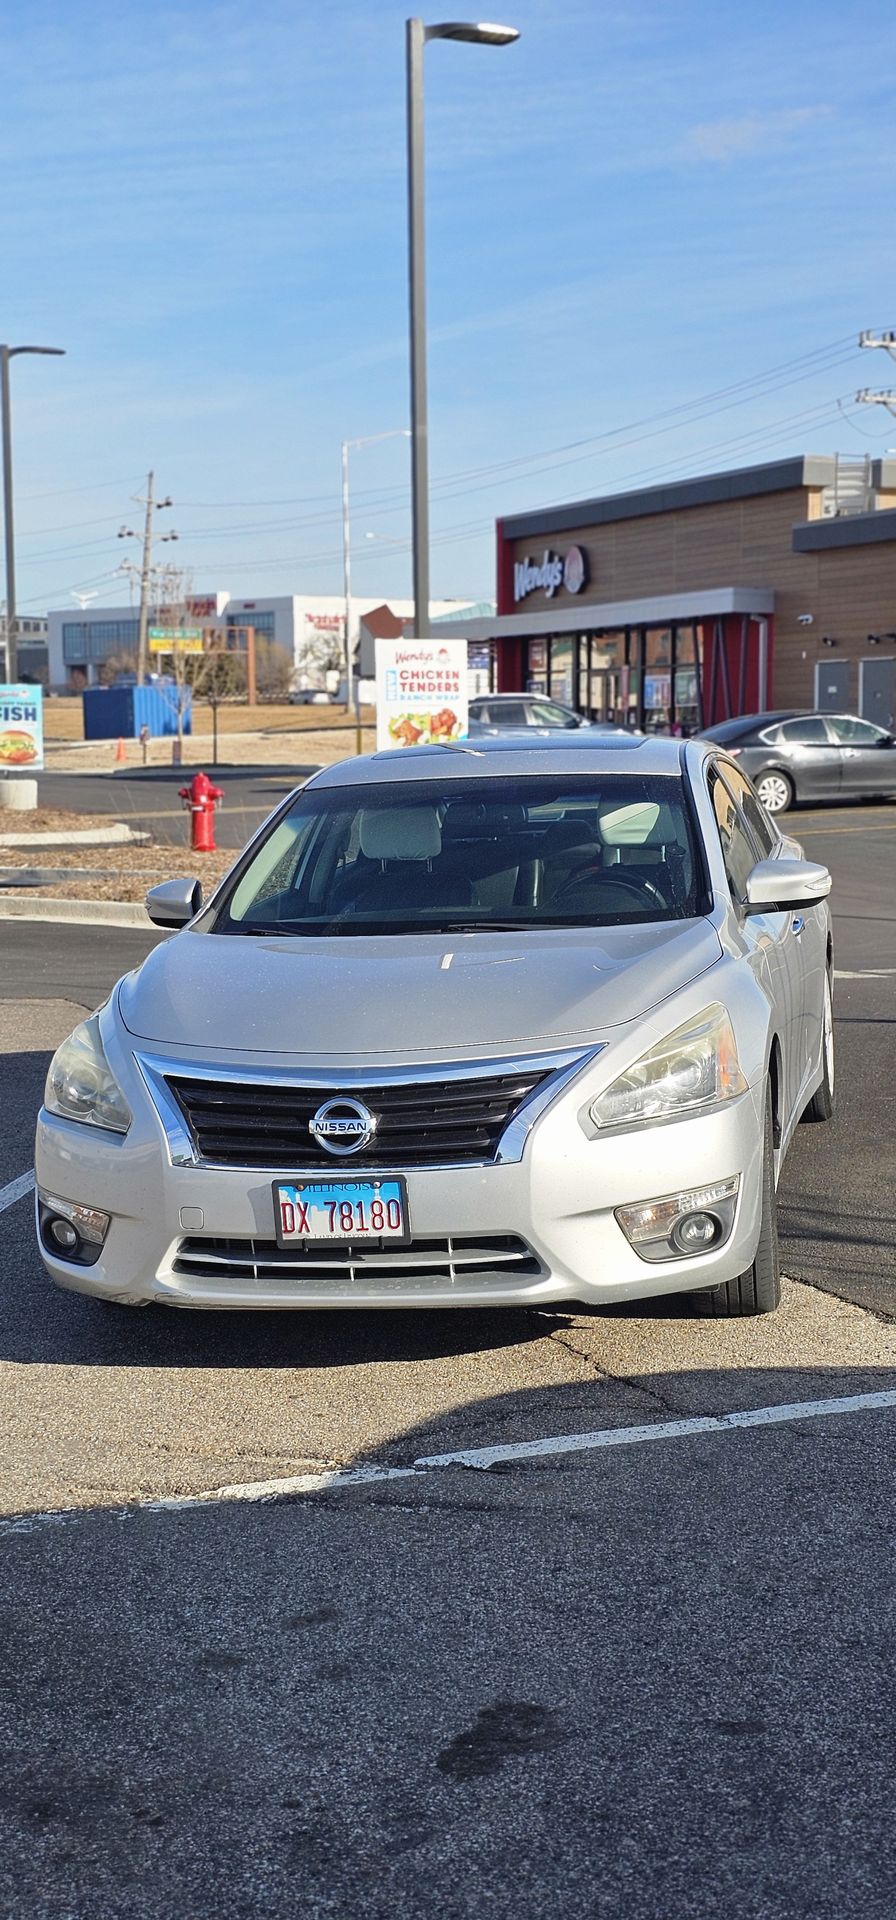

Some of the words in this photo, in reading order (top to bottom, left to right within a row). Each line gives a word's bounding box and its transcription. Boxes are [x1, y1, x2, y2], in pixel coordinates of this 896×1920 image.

[514, 549, 562, 602] Wendy's
[395, 649, 433, 665] Wendy's
[399, 670, 460, 680] CHICKEN
[400, 682, 460, 692] TENDERS
[0, 707, 37, 721] ISH
[315, 1122, 367, 1131] NISSAN
[307, 1183, 371, 1193] ILLINOIS
[281, 1201, 310, 1233] DX
[324, 1199, 401, 1232] 78180
